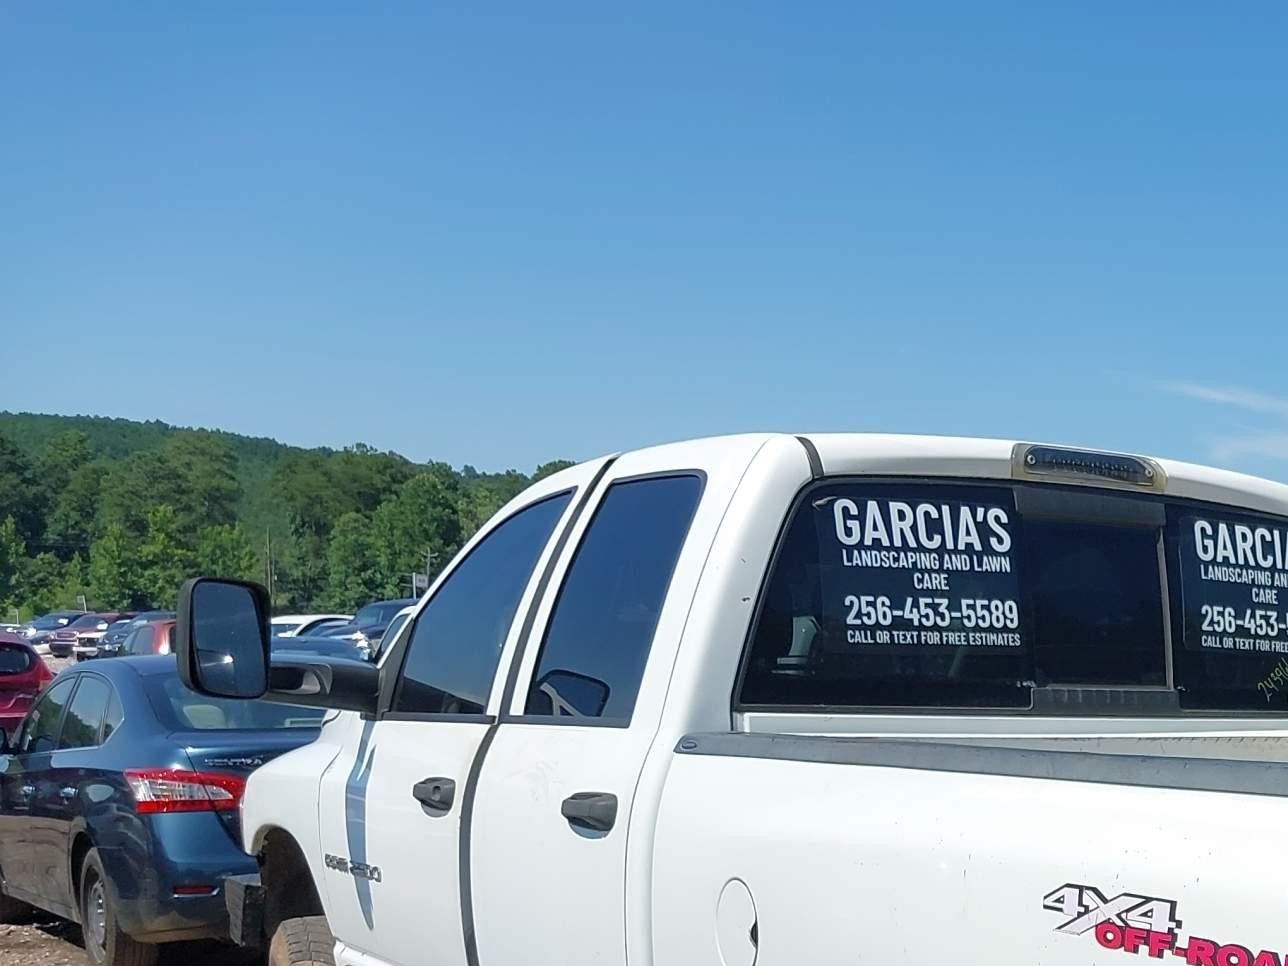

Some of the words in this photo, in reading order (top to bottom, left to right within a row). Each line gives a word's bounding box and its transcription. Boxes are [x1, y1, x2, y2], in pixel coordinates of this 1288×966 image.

[833, 498, 1012, 552] GARCIA'S
[842, 549, 940, 569] LANDSCAPING
[943, 554, 970, 571] AND
[973, 555, 1011, 573] LAWN
[913, 572, 950, 590] CARE
[1200, 564, 1272, 586] LANDSCAPING
[1251, 588, 1279, 605] CARE
[844, 595, 1019, 629] 256-453-5589
[847, 630, 874, 644] CALL
[876, 630, 891, 644] OR
[892, 631, 919, 645] TEXT
[921, 631, 941, 645] FOR
[942, 632, 968, 646] FREE
[969, 633, 1021, 647] ESTIMATES
[1201, 635, 1222, 648] CALL
[1223, 637, 1234, 649] OR
[1235, 639, 1254, 651] TEXT
[1256, 640, 1270, 652] FOR
